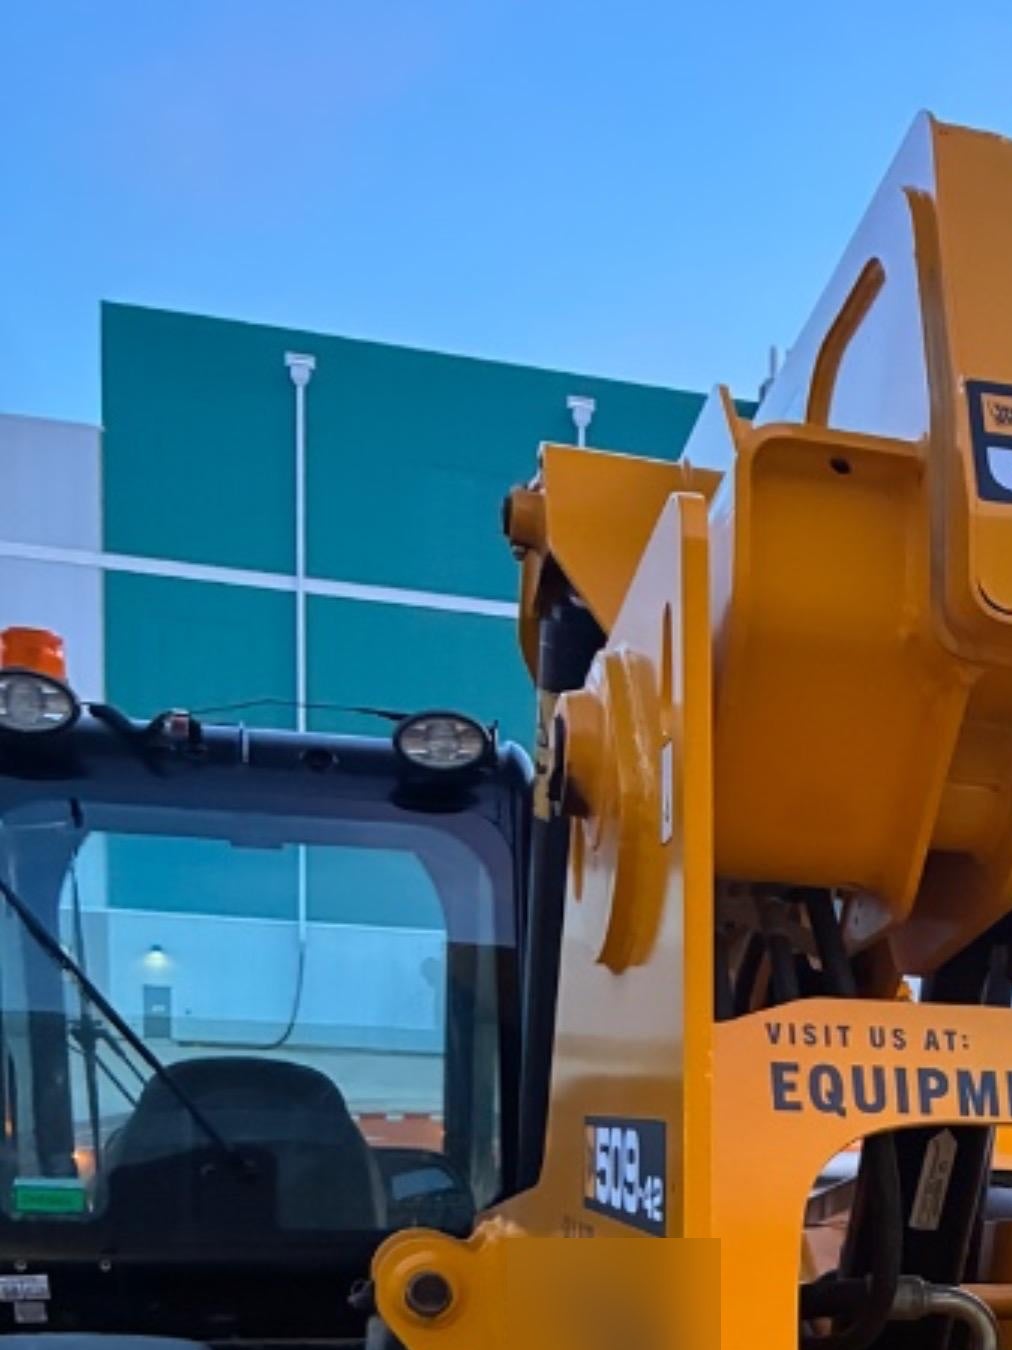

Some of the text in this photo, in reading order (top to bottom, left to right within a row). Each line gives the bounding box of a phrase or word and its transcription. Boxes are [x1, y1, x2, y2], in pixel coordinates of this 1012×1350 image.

[765, 1022, 971, 1052] VISIT US AT:
